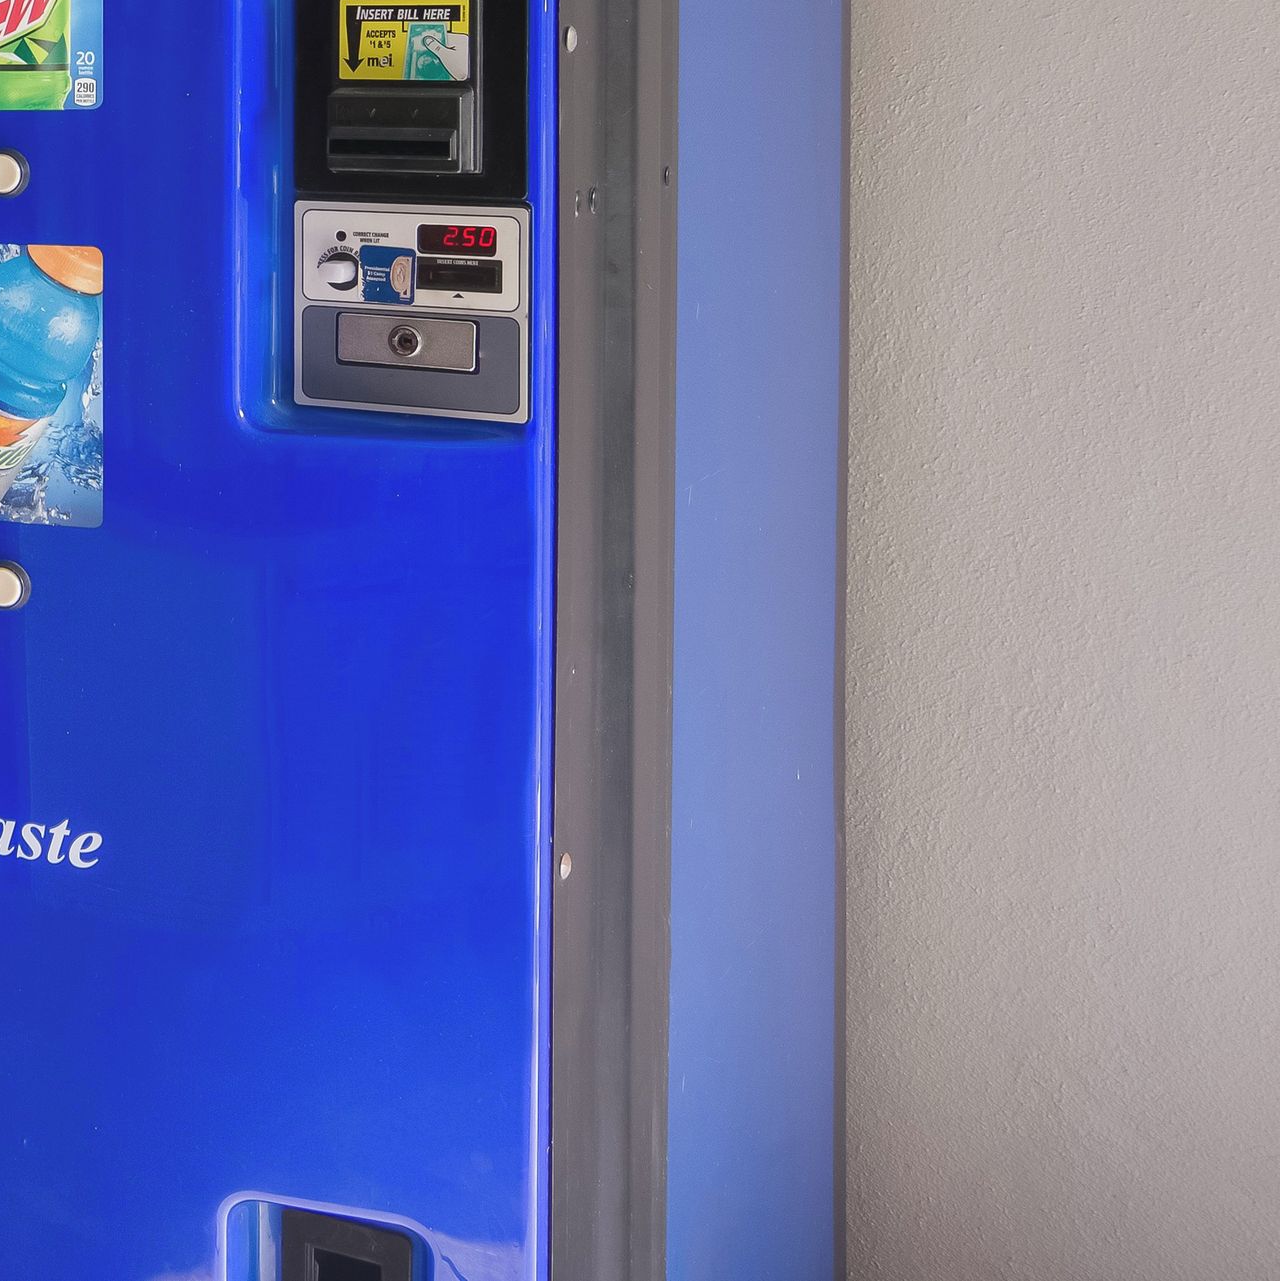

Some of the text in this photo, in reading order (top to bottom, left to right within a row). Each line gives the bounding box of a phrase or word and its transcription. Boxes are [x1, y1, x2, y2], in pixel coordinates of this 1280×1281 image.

[397, 9, 419, 20] BILL
[422, 8, 451, 20] HERE
[366, 30, 396, 39] ACCEPTS
[76, 51, 95, 65] 20
[77, 82, 95, 93] 290
[340, 245, 354, 254] COIN
